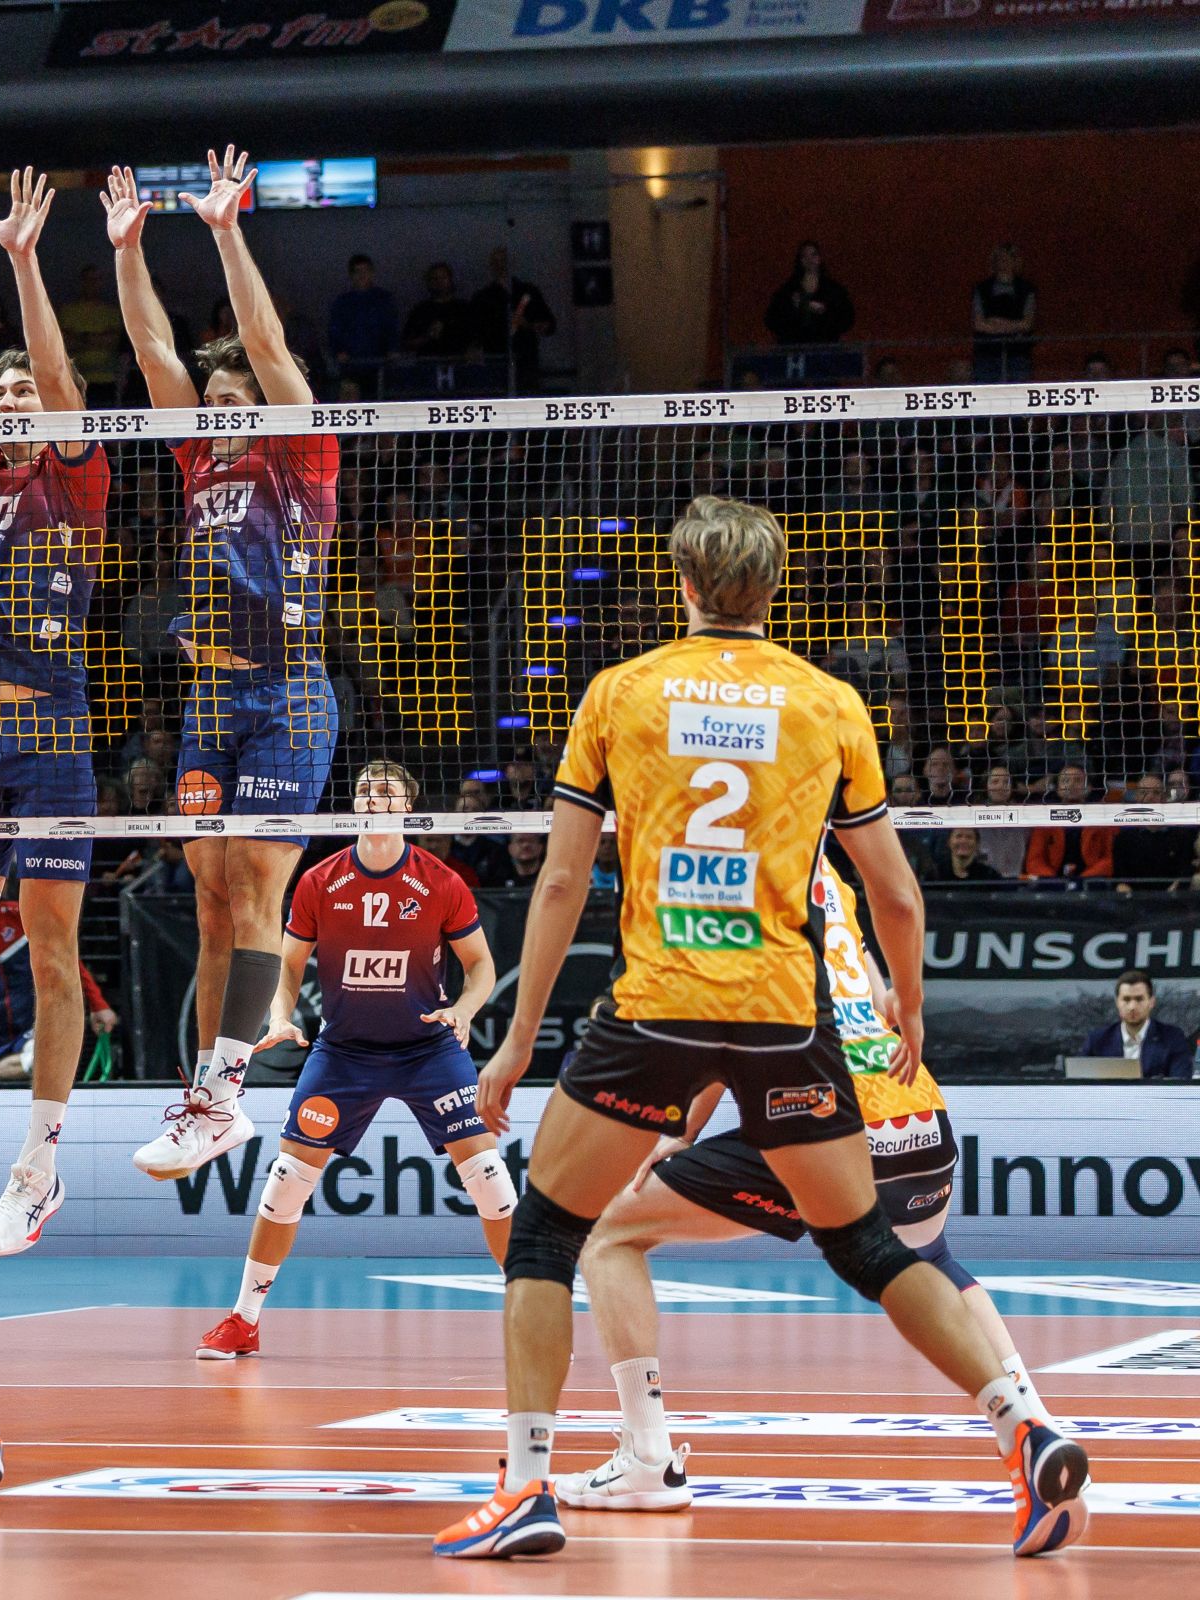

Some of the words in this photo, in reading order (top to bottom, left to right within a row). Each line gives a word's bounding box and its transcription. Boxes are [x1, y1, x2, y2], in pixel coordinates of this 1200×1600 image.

[663, 678, 786, 707] KNIGGE
[702, 715, 766, 737] forvis
[681, 730, 765, 751] mazars
[256, 777, 300, 793] MEYER
[180, 789, 217, 806] maz
[685, 761, 751, 850] 2
[128, 823, 150, 831] BERLIN
[25, 857, 42, 868] ROY
[44, 858, 85, 871] ROBSON
[668, 852, 748, 887] DKB
[326, 871, 356, 895] willke
[401, 872, 430, 897] willke
[718, 888, 743, 901] Bank
[333, 902, 354, 911] JAKO
[361, 892, 390, 928] 12
[663, 912, 754, 945] LIGO
[349, 956, 402, 979] LKH
[301, 1107, 336, 1128] maz
[446, 1120, 463, 1134] ROY
[866, 1130, 939, 1154] Securitas
